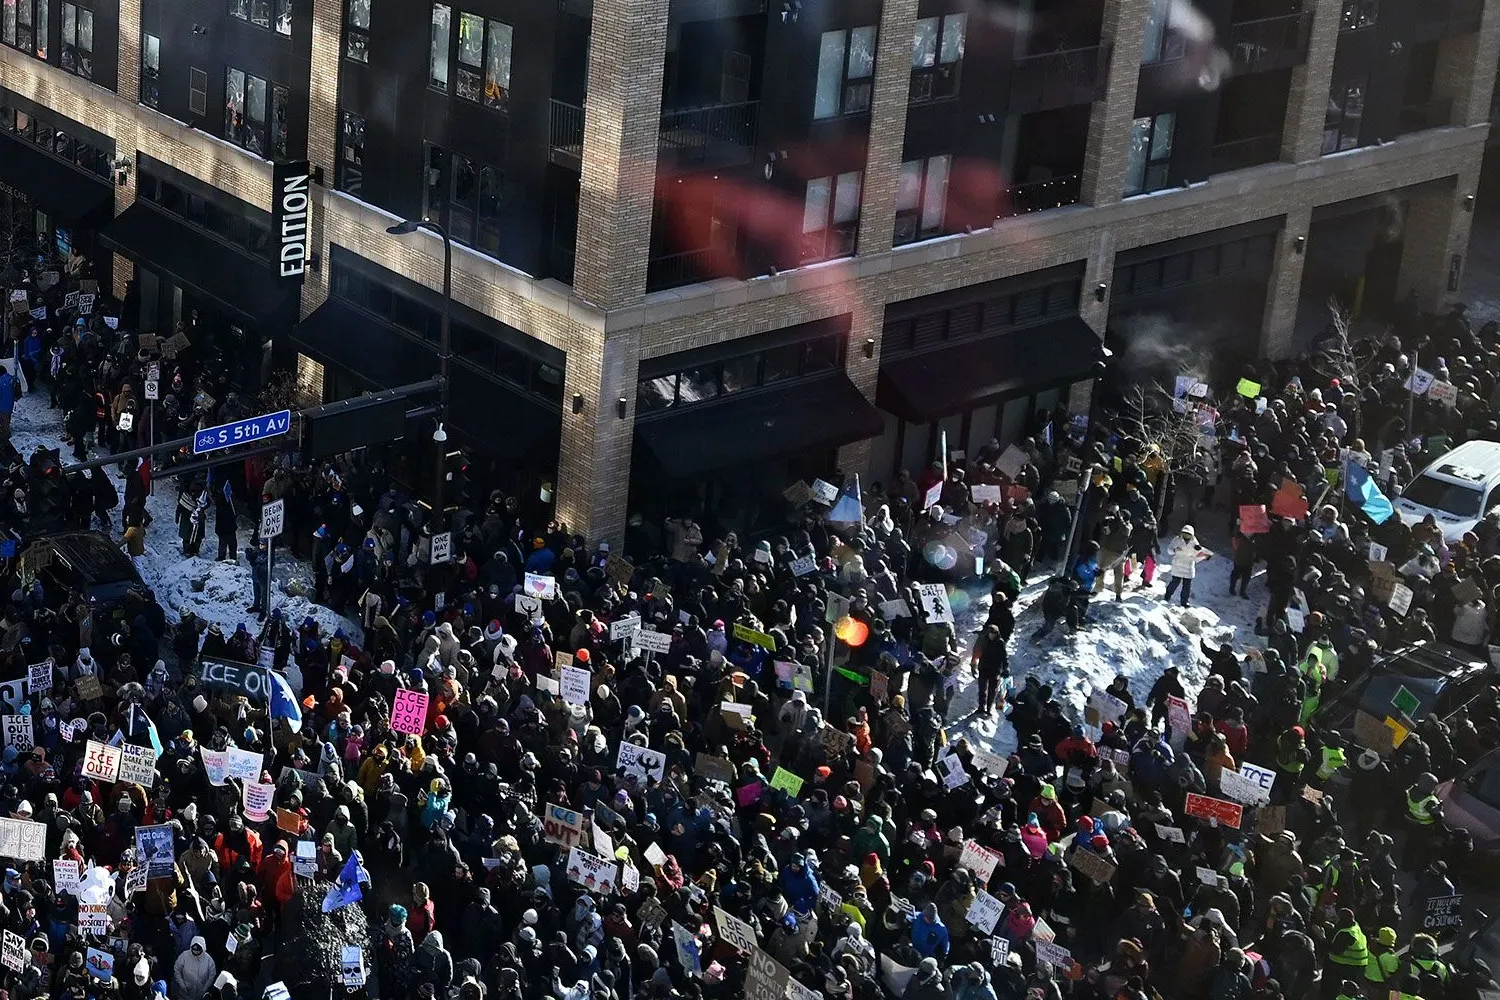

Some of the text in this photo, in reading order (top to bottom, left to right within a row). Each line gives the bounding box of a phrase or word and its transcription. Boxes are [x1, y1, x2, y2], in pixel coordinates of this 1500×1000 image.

[280, 174, 309, 277] EDITION
[218, 418, 286, 444] S 5th Av
[264, 502, 283, 518] BEGIN
[265, 515, 282, 527] ONE
[264, 524, 280, 537] WAY
[434, 534, 448, 544] ONE
[434, 543, 448, 552] WAY
[201, 661, 241, 688] ICE
[397, 689, 426, 705] ICE
[395, 701, 425, 716] OUT
[8, 715, 29, 723] ICE
[394, 713, 420, 726] FOR
[7, 724, 31, 734] OUT
[392, 721, 421, 733] GOOD
[11, 733, 31, 743] FOR
[123, 744, 141, 756] ICE
[621, 750, 636, 760] OUT
[622, 744, 634, 754] ICE
[88, 750, 115, 767] ICE
[619, 757, 636, 766] NOW
[87, 761, 114, 778] OUT!
[1243, 766, 1273, 790] ICE
[3, 820, 44, 842] FUCK
[545, 820, 580, 846] OUT
[7, 842, 37, 859] ICE
[967, 841, 992, 864] HATE
[77, 904, 107, 913] NO KINGS
[1434, 906, 1451, 916] ICE
[77, 919, 88, 927] NO
[724, 915, 745, 937] BE
[4, 931, 24, 949] SAY
[752, 950, 777, 977] NO
